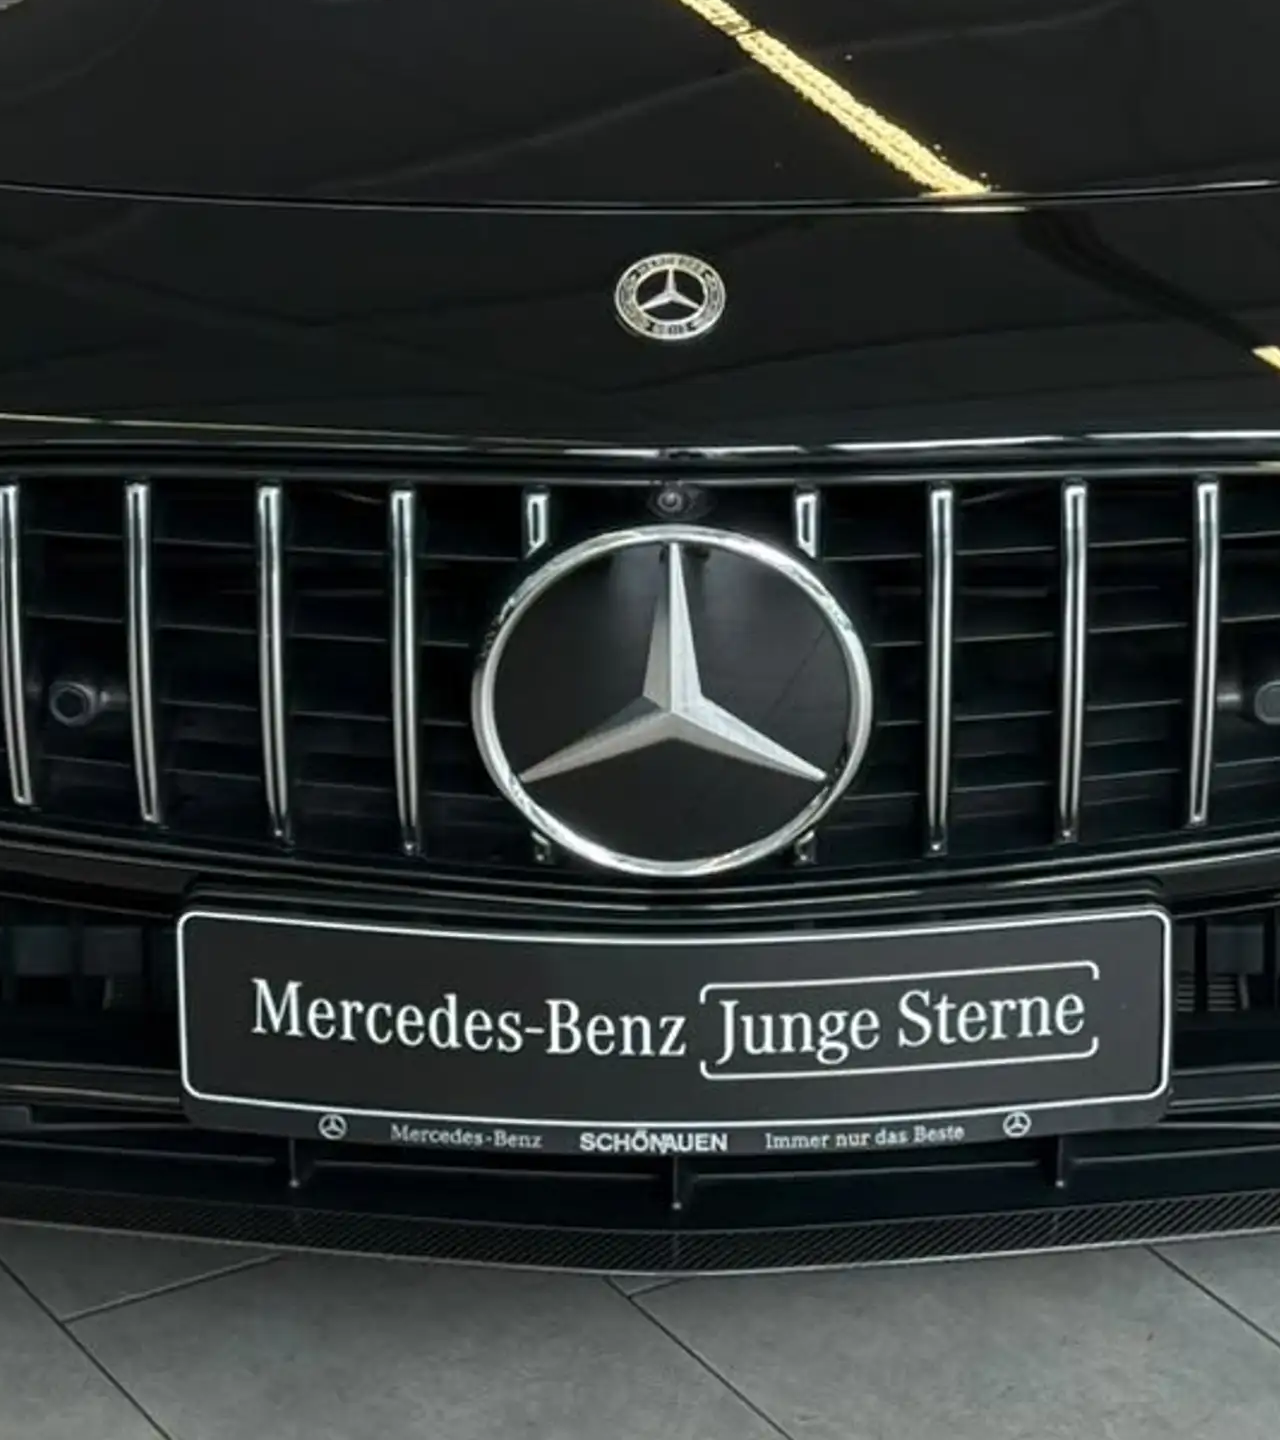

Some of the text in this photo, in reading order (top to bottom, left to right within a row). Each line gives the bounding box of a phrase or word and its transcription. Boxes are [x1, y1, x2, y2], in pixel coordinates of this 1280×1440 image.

[250, 977, 1086, 1066] Mercedes-Benz Junge Sterne
[389, 1123, 544, 1150] Mercedes-Benz
[765, 1132, 830, 1150] Immer
[835, 1131, 871, 1148] nur
[874, 1127, 908, 1146] das
[913, 1123, 966, 1143] Beste
